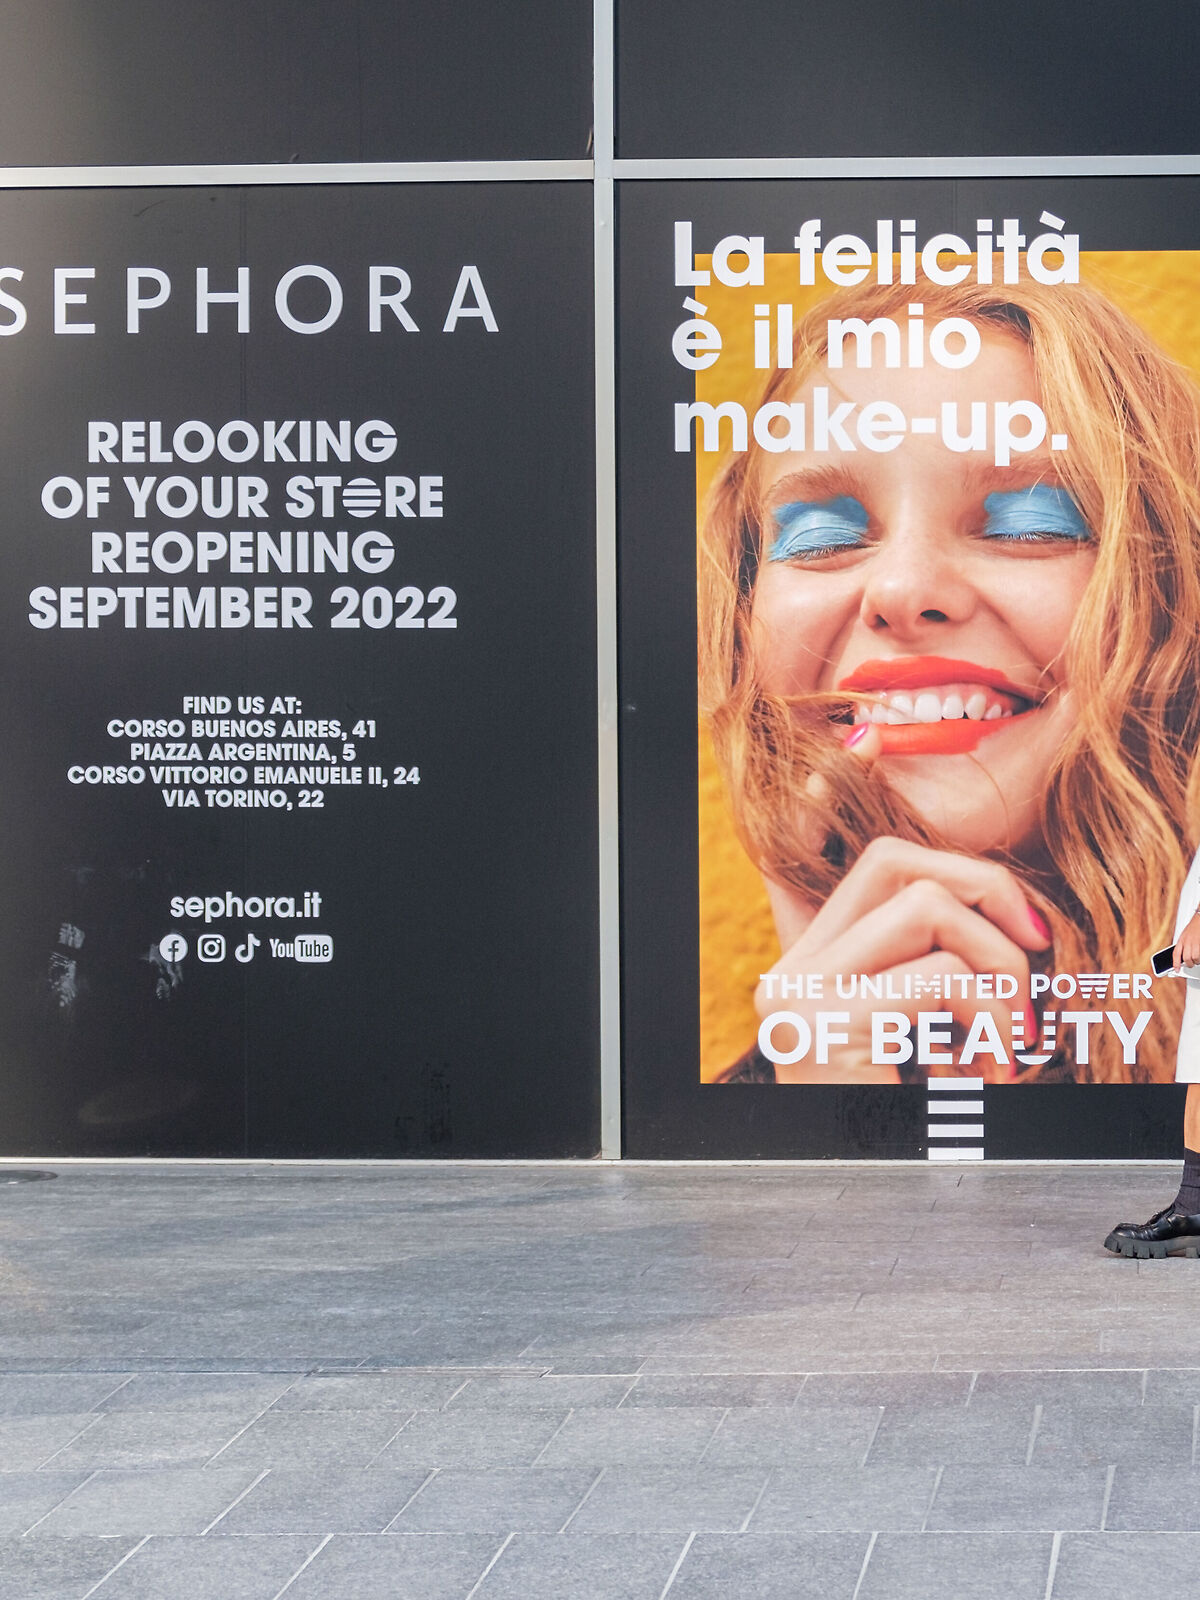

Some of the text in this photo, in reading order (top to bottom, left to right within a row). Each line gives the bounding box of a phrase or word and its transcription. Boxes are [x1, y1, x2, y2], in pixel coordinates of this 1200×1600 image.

[674, 210, 1080, 287] La felicità
[0, 265, 500, 335] SEPHORA
[672, 296, 981, 370] è il mio
[87, 419, 398, 464] RELOOKING
[674, 386, 1068, 467] make-up.
[40, 474, 444, 519] OF YOUR STORE
[91, 530, 396, 575] REOPENING
[28, 585, 458, 630] SEPTEMBER 2022
[182, 696, 303, 715] FIND US AT:
[106, 719, 377, 741] CORSO BUENOS AIRES, 41
[130, 742, 357, 765] PIAZZA ARGENTINA, 5
[67, 766, 421, 788] CORSO VITTORIO EMANUELE II, 24
[161, 789, 325, 811] VIA TORINO, 22
[169, 890, 323, 923] sephora.it
[269, 936, 332, 961] YouTube
[759, 973, 1154, 1000] THE UNLIMITED POWER
[757, 1010, 1154, 1065] OF BEAUTY
